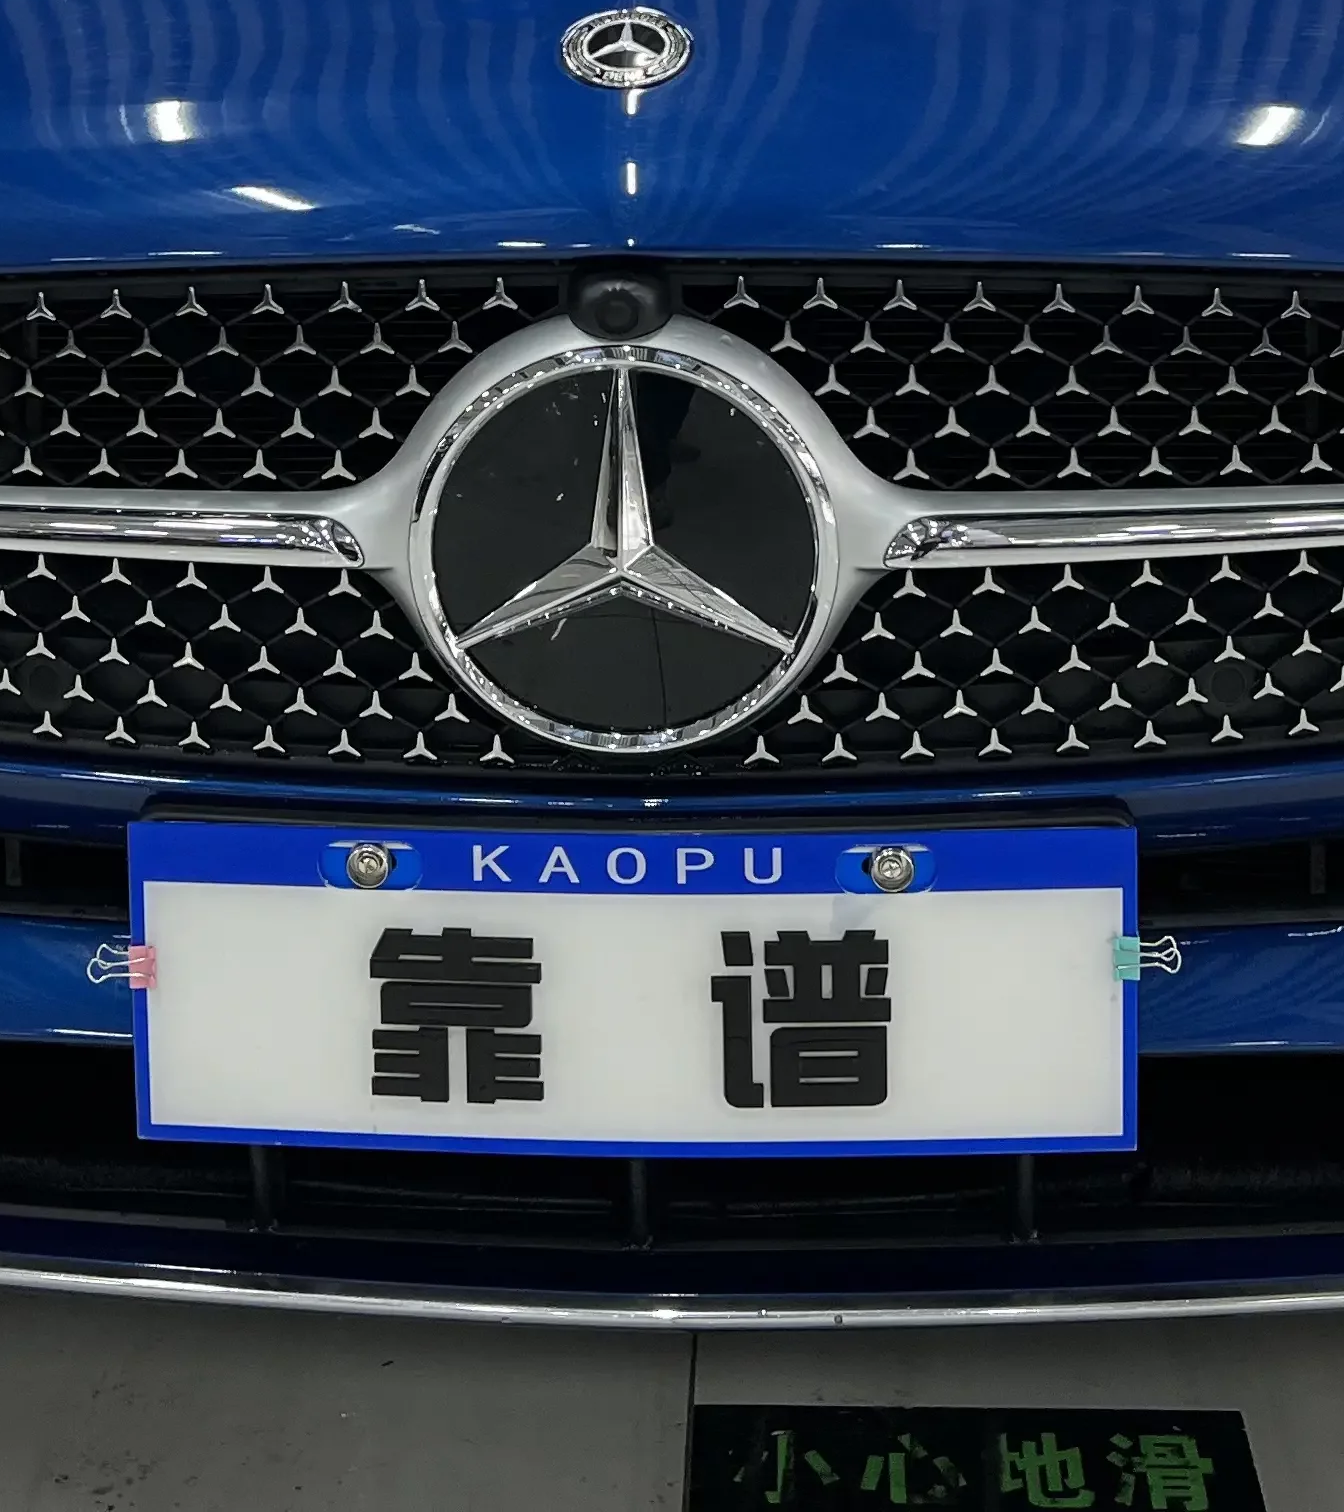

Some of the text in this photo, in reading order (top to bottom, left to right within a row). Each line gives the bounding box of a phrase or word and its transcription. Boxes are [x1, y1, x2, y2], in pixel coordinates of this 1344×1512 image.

[471, 844, 784, 885] KAOPU
[369, 927, 892, 1109] 靠谱
[730, 1429, 1214, 1511] 小心地滑
